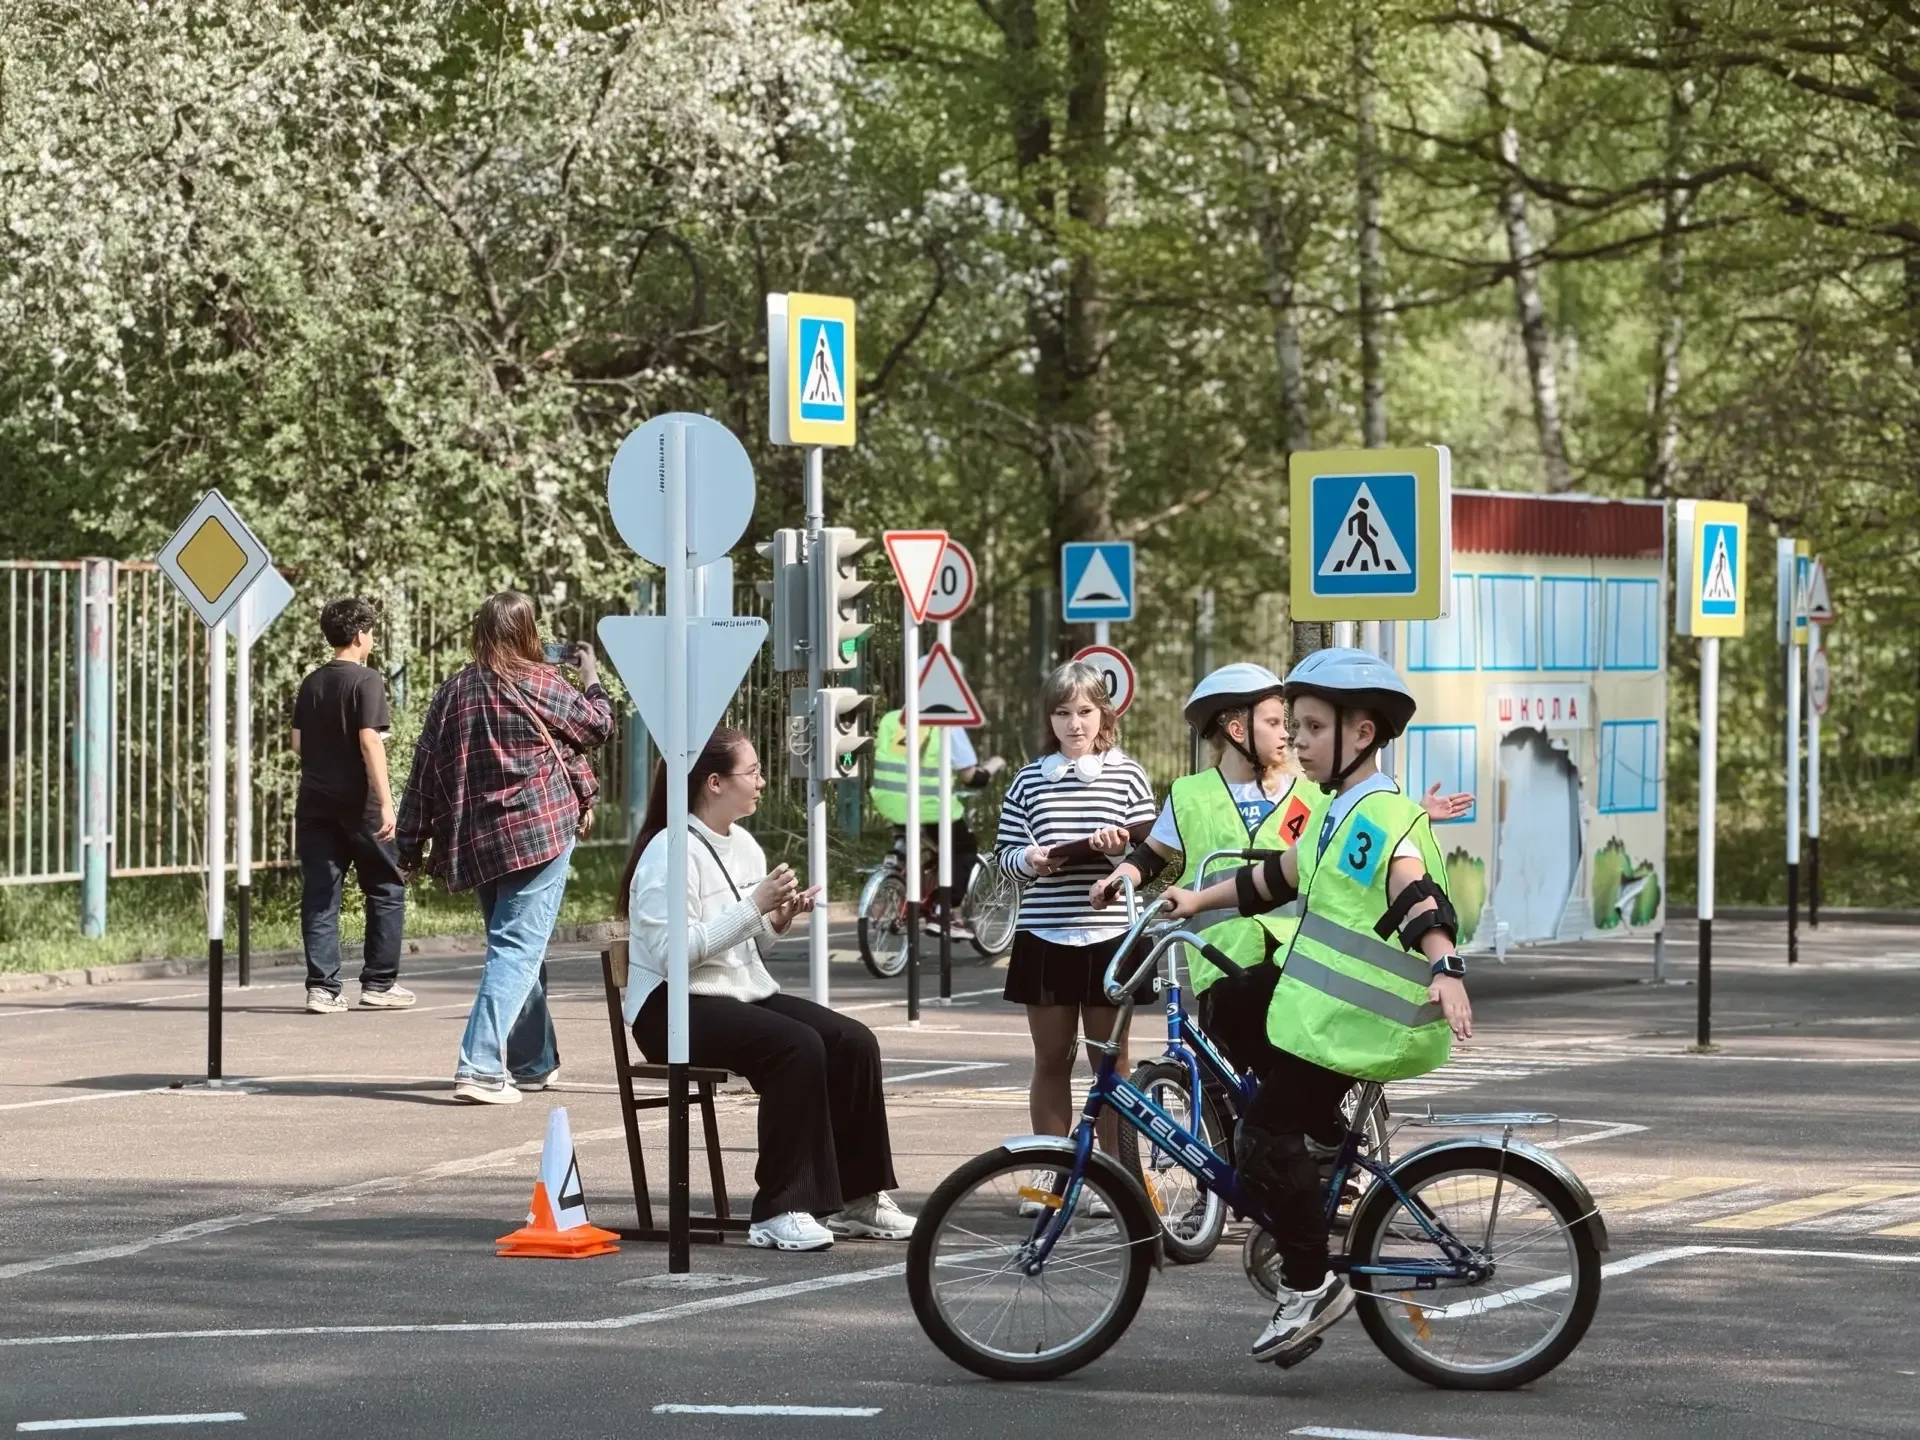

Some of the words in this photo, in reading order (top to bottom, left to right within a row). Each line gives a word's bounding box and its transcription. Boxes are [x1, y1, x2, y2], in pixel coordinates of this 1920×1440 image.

[931, 565, 957, 596] 0
[1498, 697, 1577, 721] ШКОЛА
[1287, 813, 1305, 841] 4
[1348, 831, 1372, 870] 3
[1111, 1083, 1209, 1168] STELS
